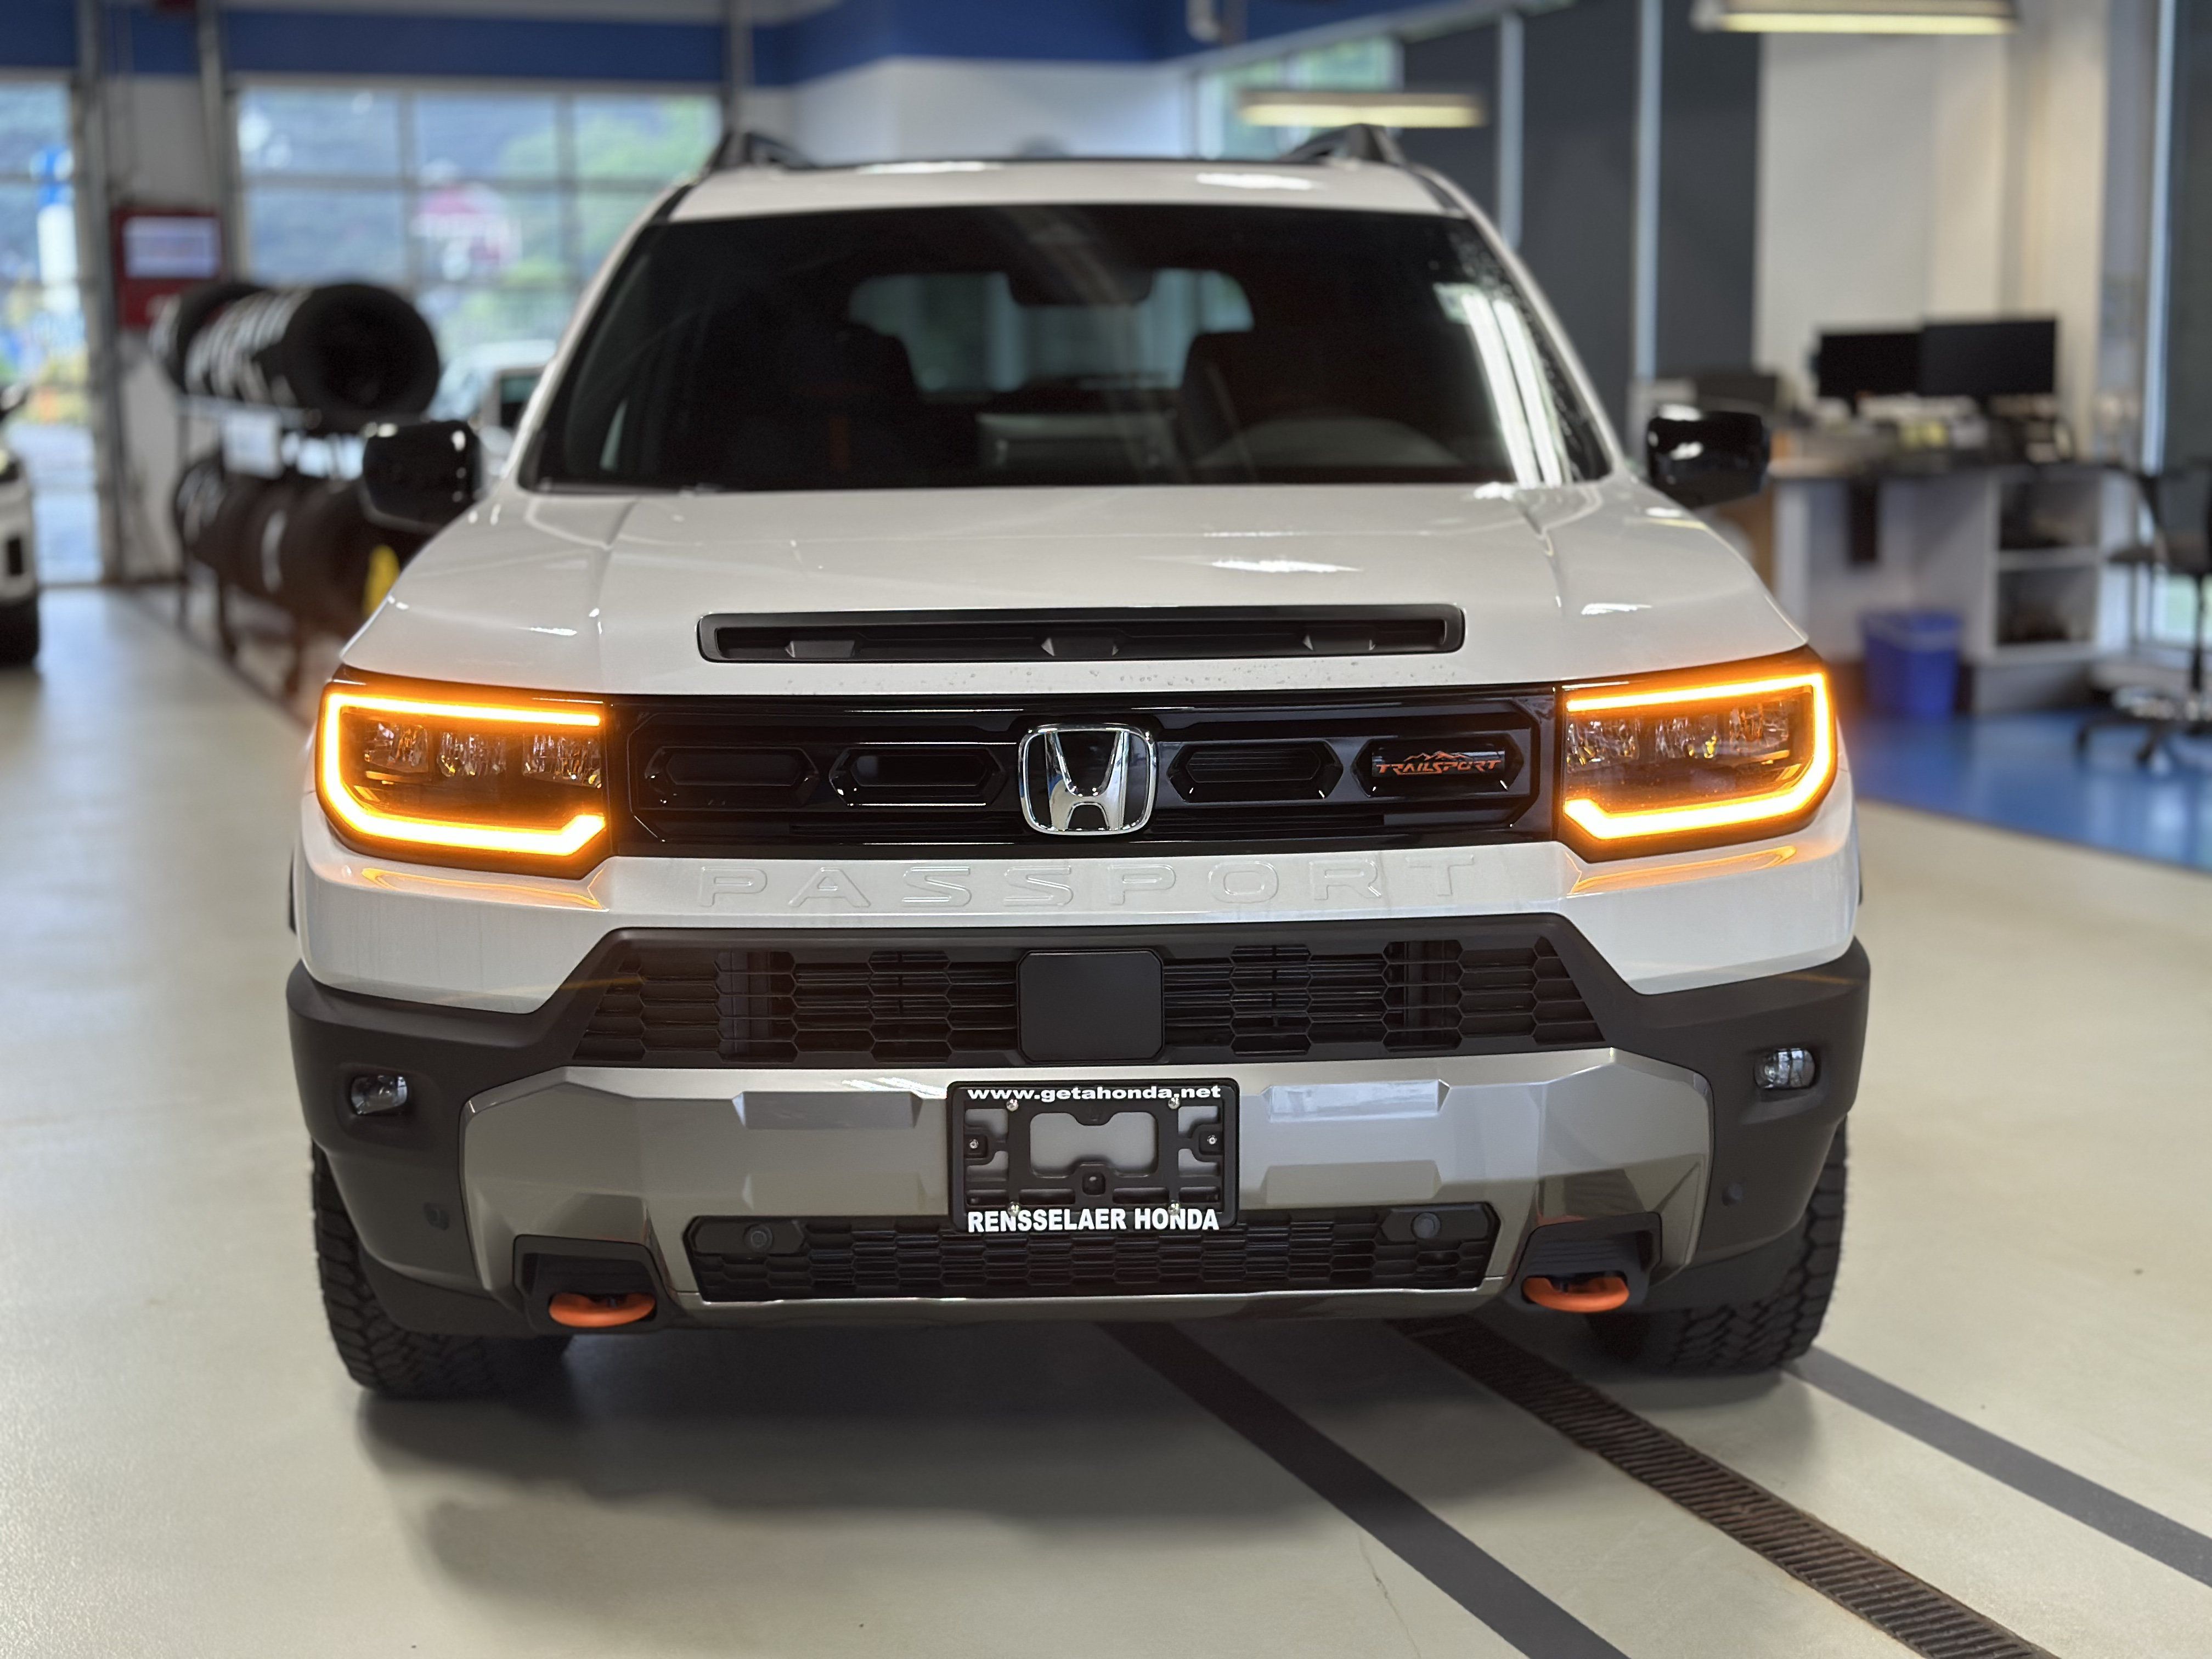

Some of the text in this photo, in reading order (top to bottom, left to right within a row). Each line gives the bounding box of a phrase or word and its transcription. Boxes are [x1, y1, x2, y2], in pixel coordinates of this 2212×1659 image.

[1376, 760, 1501, 775] TRAILSPORT
[698, 855, 1475, 909] PASSPORT
[967, 1085, 1221, 1103] www.getahonda.net
[968, 1208, 1220, 1233] RENSSELAER HONDA
